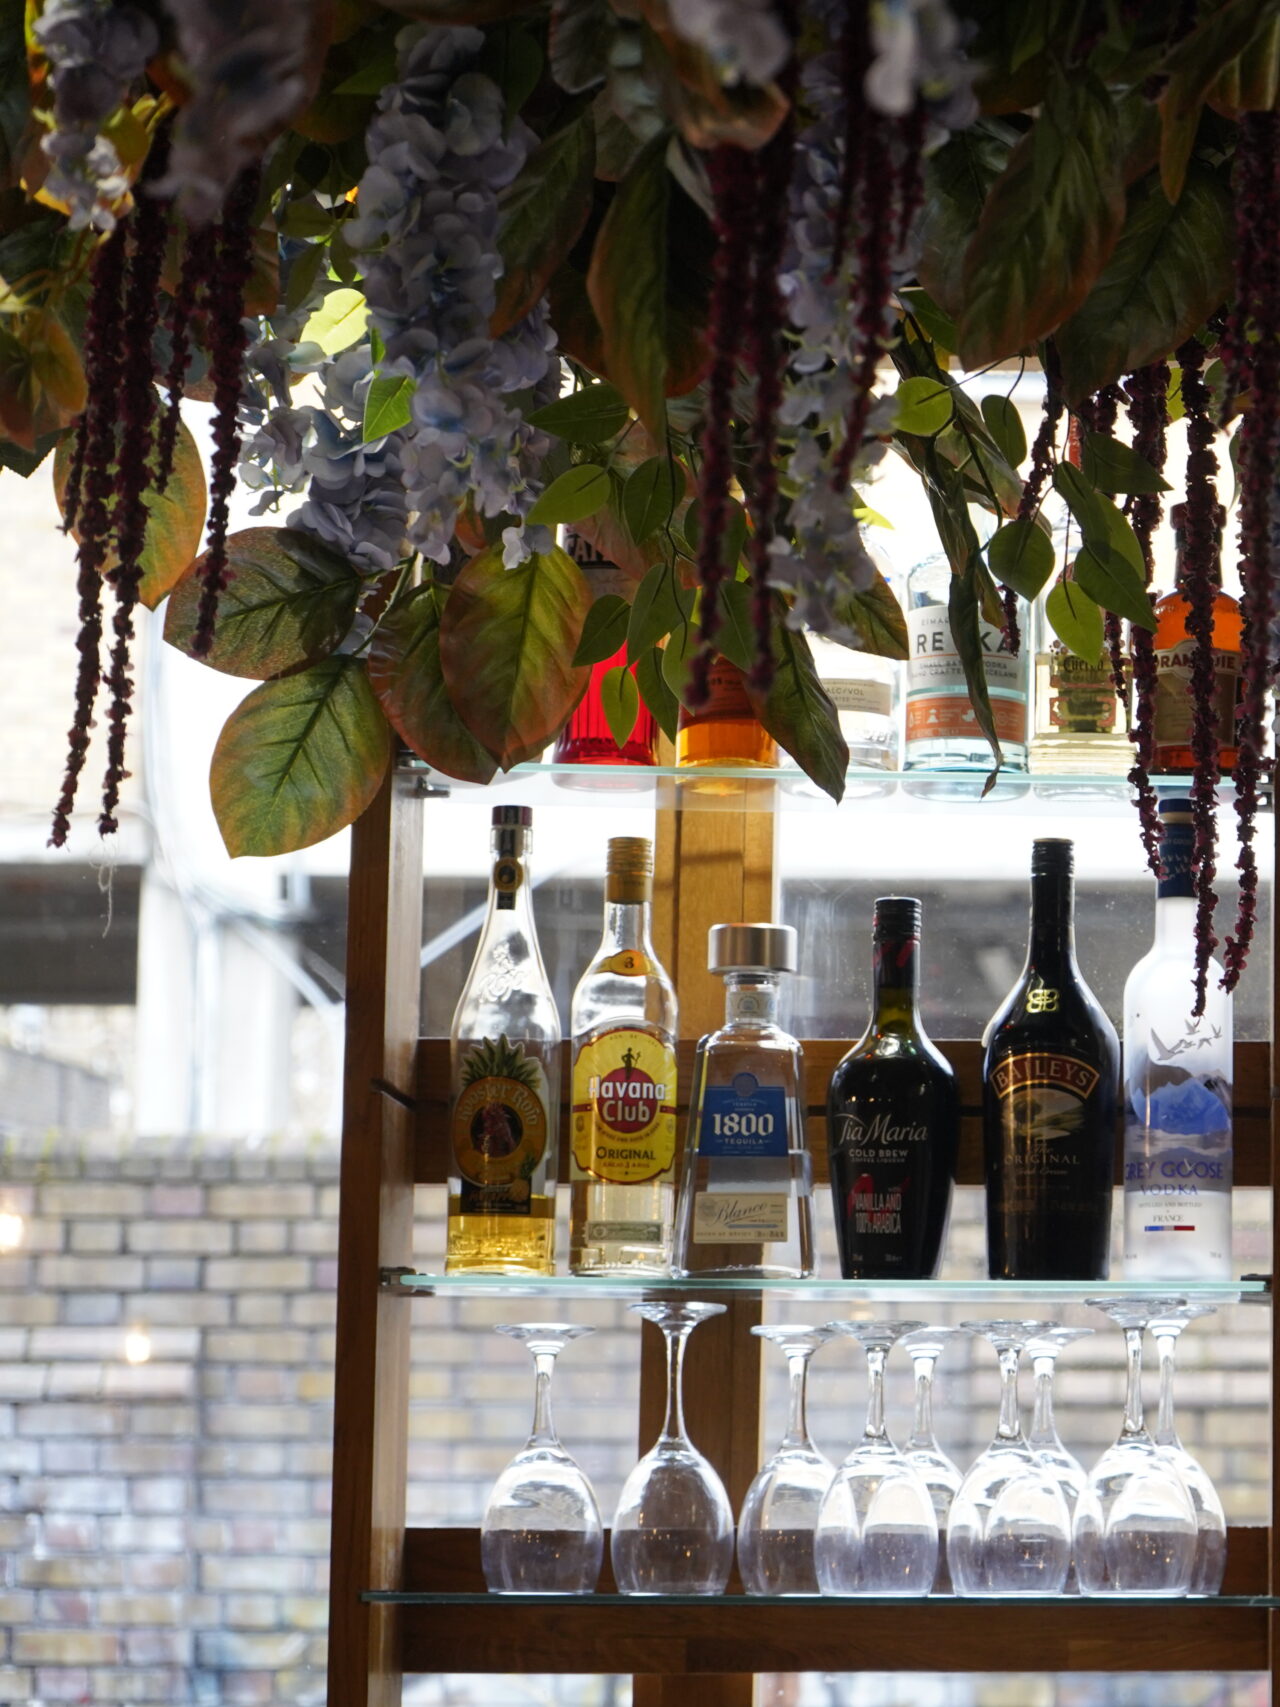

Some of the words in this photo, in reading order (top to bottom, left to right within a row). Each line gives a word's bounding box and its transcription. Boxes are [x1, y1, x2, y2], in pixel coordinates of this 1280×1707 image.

[917, 632, 1012, 654] REKA
[995, 1059, 1091, 1089] BAILEYS
[589, 1076, 665, 1100] Havana
[602, 1100, 650, 1122] Club
[712, 1113, 774, 1136] 1800
[834, 1113, 867, 1146] Tia
[860, 1113, 927, 1146] Maria
[596, 1147, 656, 1160] ORIGINAL
[849, 1149, 875, 1157] COLD
[879, 1149, 909, 1157] BREW
[1004, 1155, 1080, 1165] ORIGINAL
[1161, 1160, 1223, 1179] GOOSE
[1140, 1184, 1198, 1196] VODKA
[708, 1200, 768, 1227] Blanco
[1153, 1215, 1184, 1223] FRANCE
